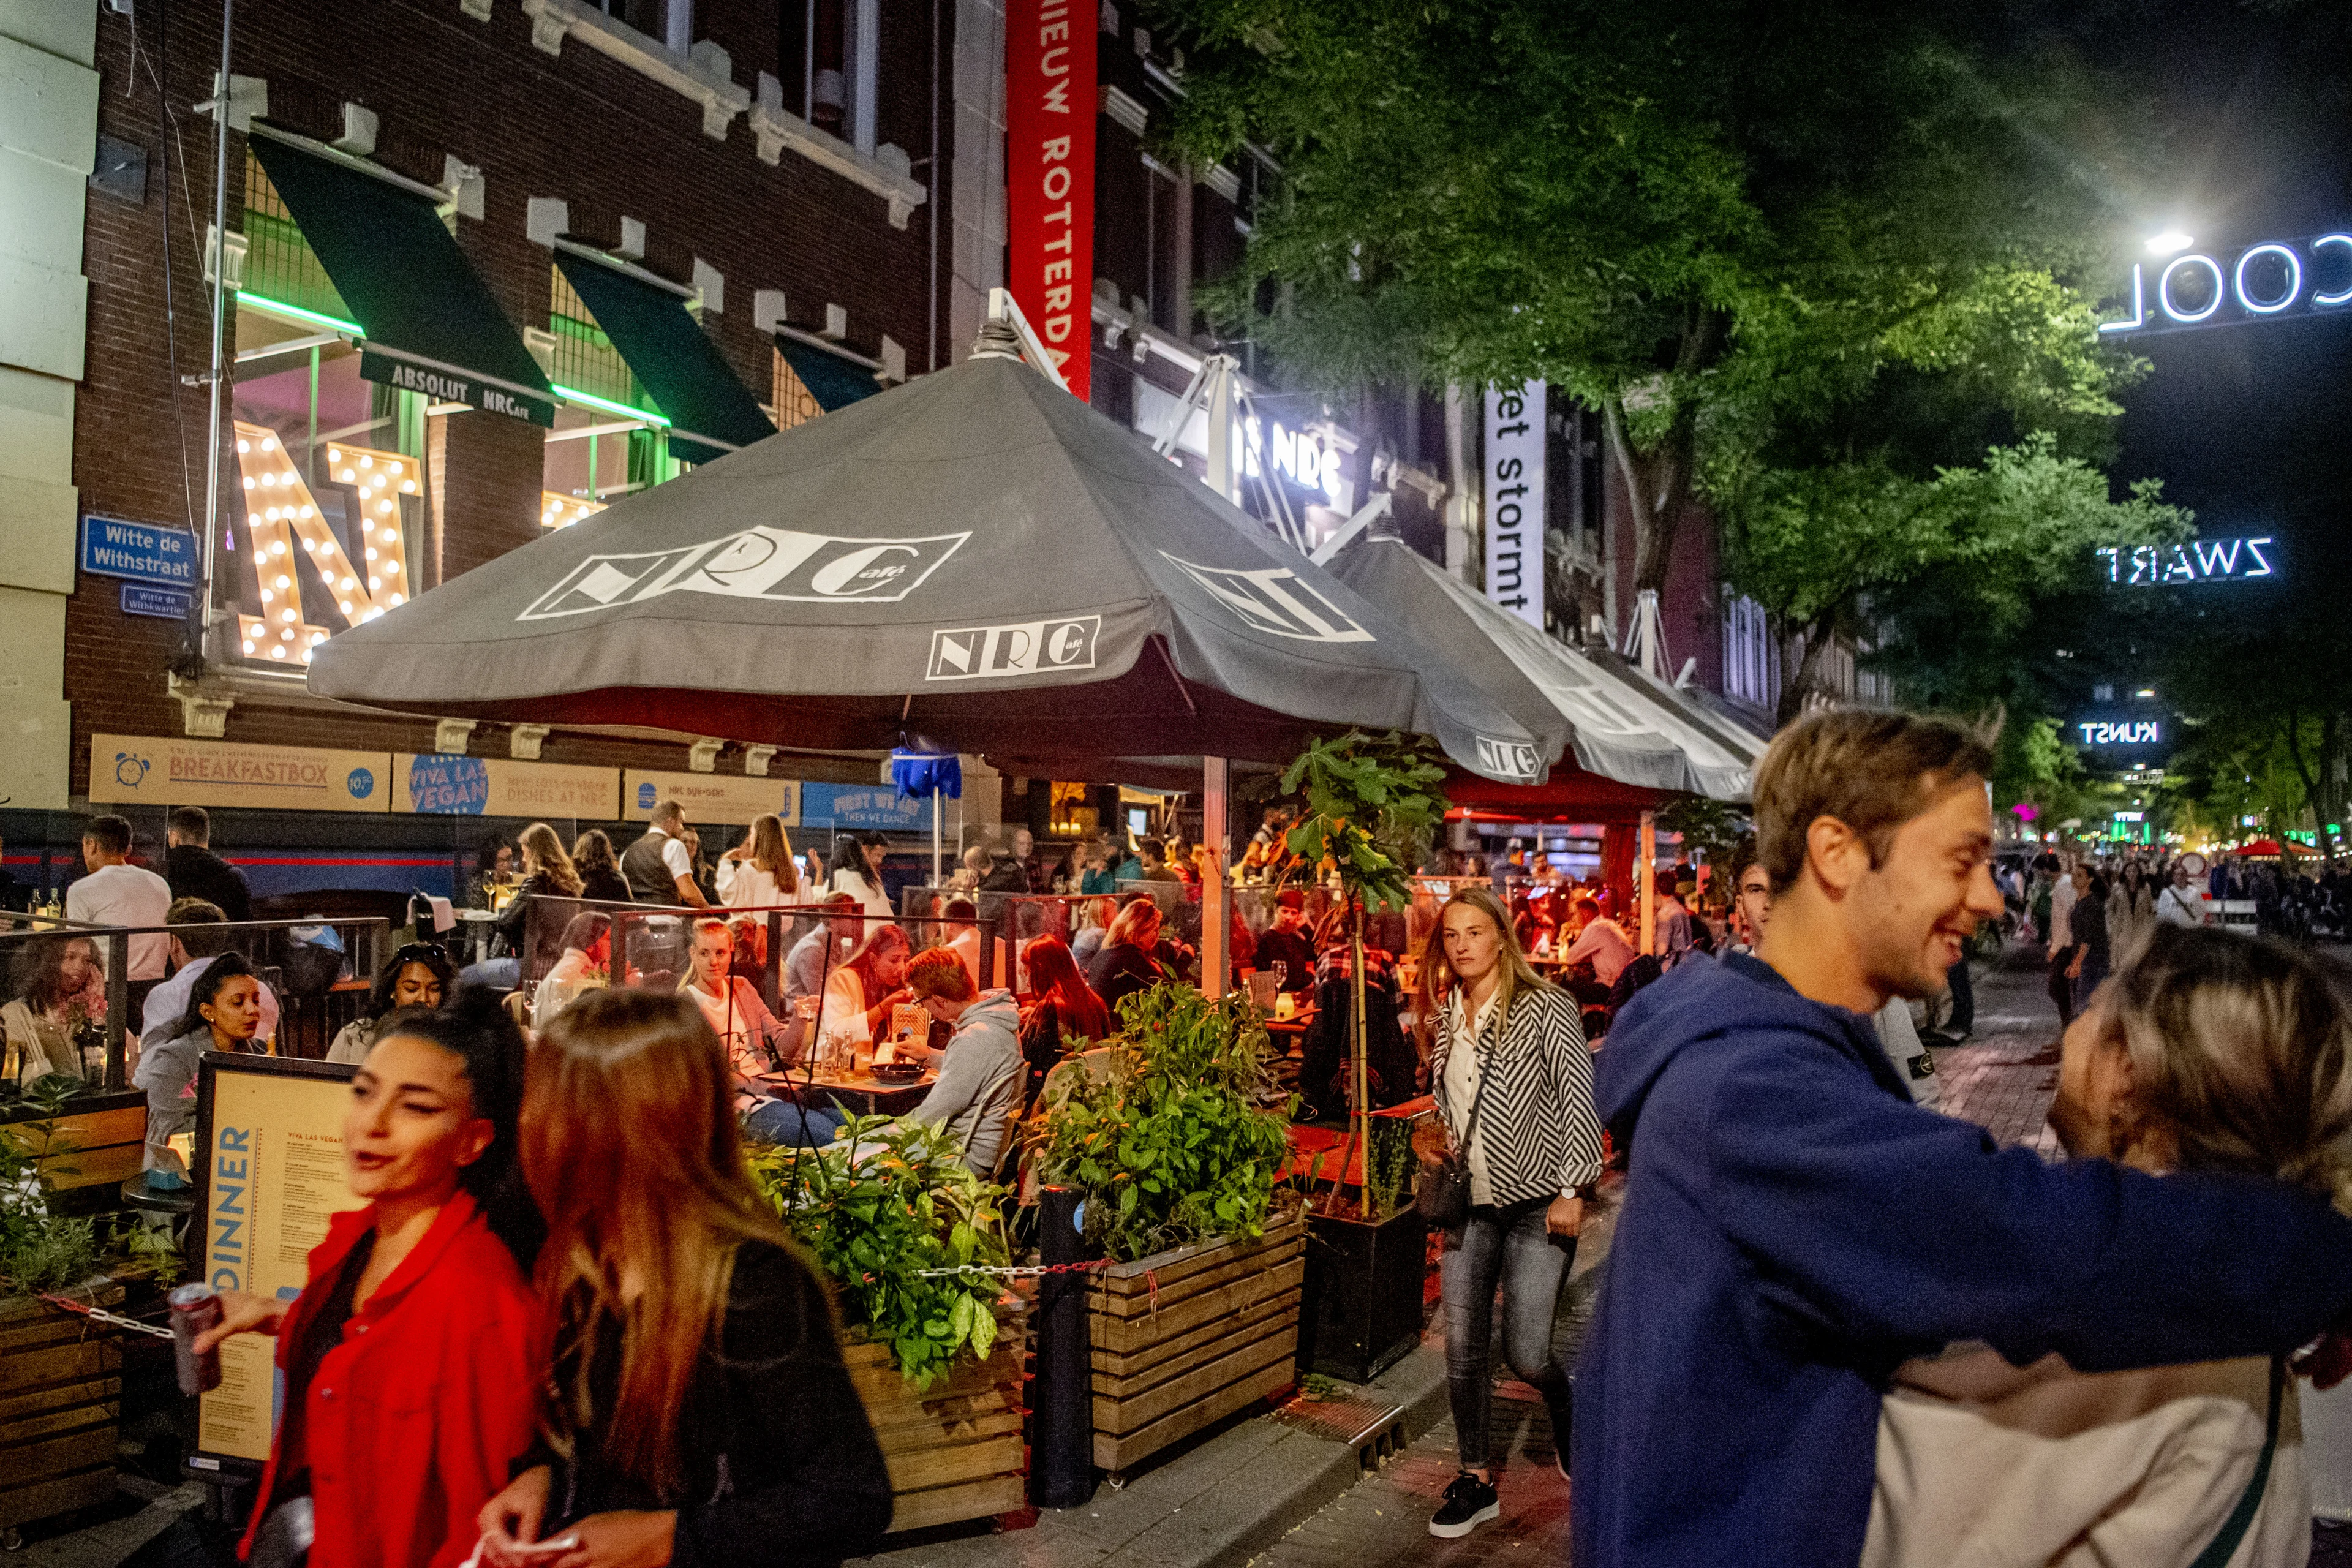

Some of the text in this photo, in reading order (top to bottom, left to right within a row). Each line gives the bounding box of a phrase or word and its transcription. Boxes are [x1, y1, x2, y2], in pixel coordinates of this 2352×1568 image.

[1041, 135, 1072, 385] ROTTERDA
[391, 365, 468, 402] ABSOLUT
[1496, 386, 1529, 611] et stormt
[106, 524, 181, 552] Witte de
[94, 546, 189, 578] Withstraat
[140, 592, 176, 603] Witte de
[937, 623, 1085, 675] NRC
[170, 756, 329, 784] BREAKFASTBOX
[410, 767, 449, 787] VIVA
[410, 780, 487, 809] VEGAN
[845, 812, 910, 824] THEN WE DANCE
[211, 1126, 250, 1294] DINNER
